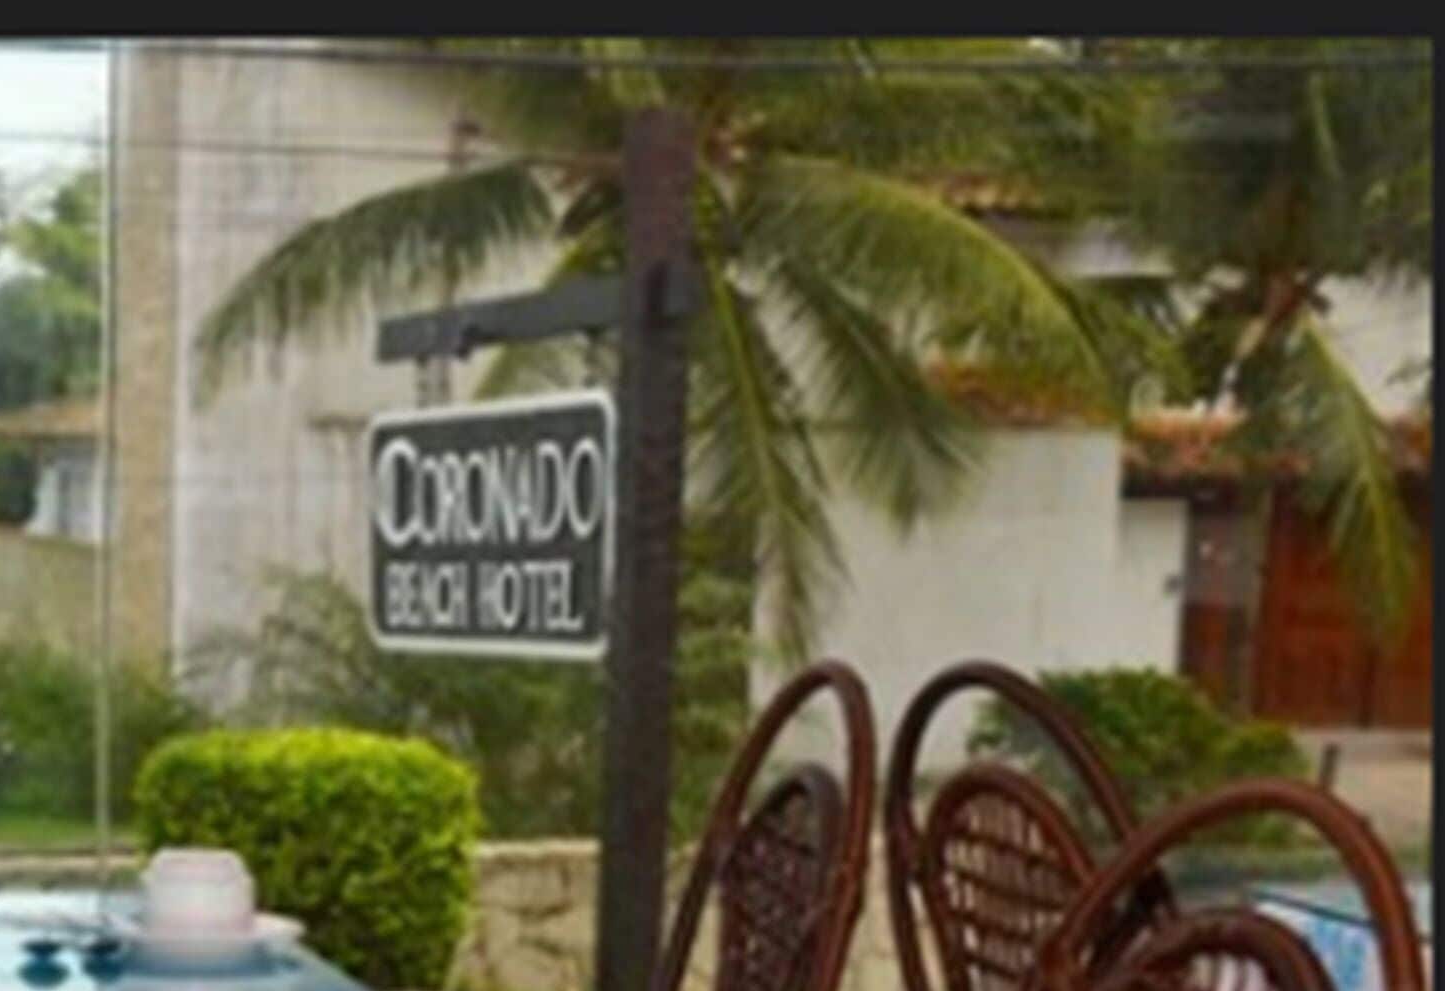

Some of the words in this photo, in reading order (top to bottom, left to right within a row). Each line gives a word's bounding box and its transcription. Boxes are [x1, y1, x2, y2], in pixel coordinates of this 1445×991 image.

[376, 436, 603, 546] CORONADO
[384, 559, 469, 628] BEACH
[476, 558, 585, 632] HOTEL
